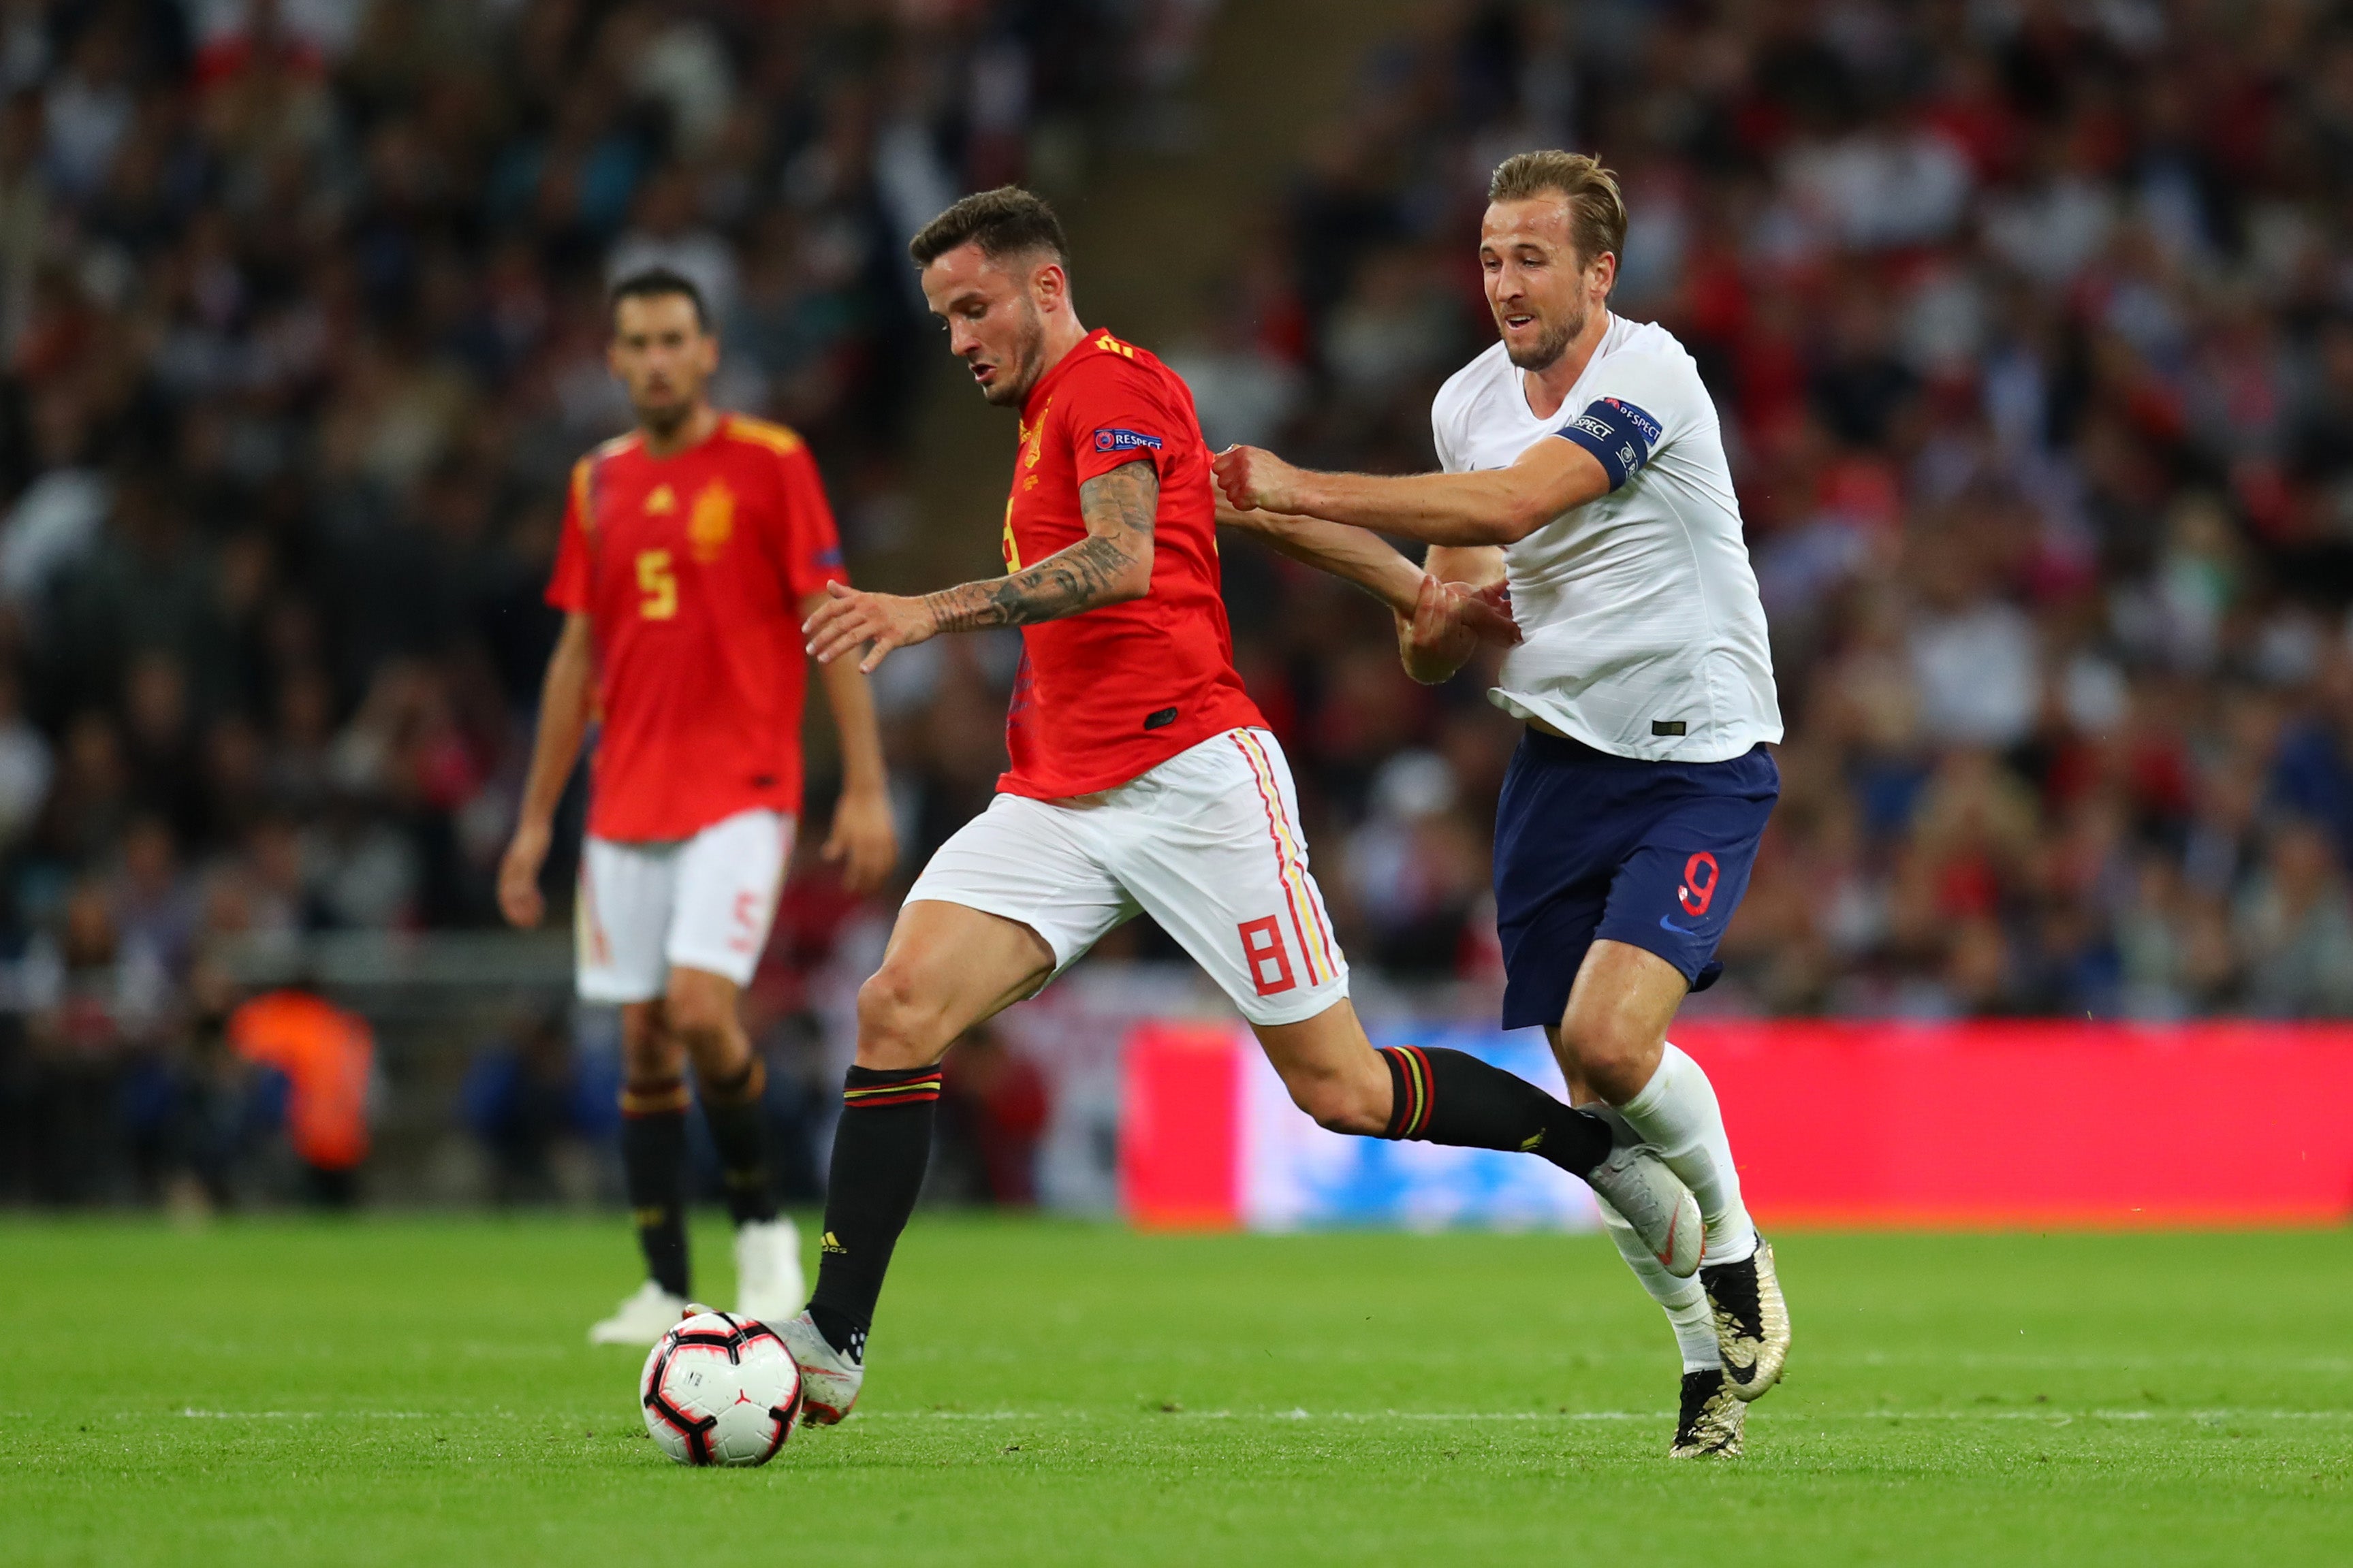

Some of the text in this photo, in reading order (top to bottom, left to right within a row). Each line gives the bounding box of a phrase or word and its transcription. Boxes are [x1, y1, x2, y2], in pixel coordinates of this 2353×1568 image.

[1575, 418, 1612, 437] SPECT
[635, 549, 678, 620] 5
[1677, 851, 1720, 917] 9
[1237, 914, 1297, 997] 8
